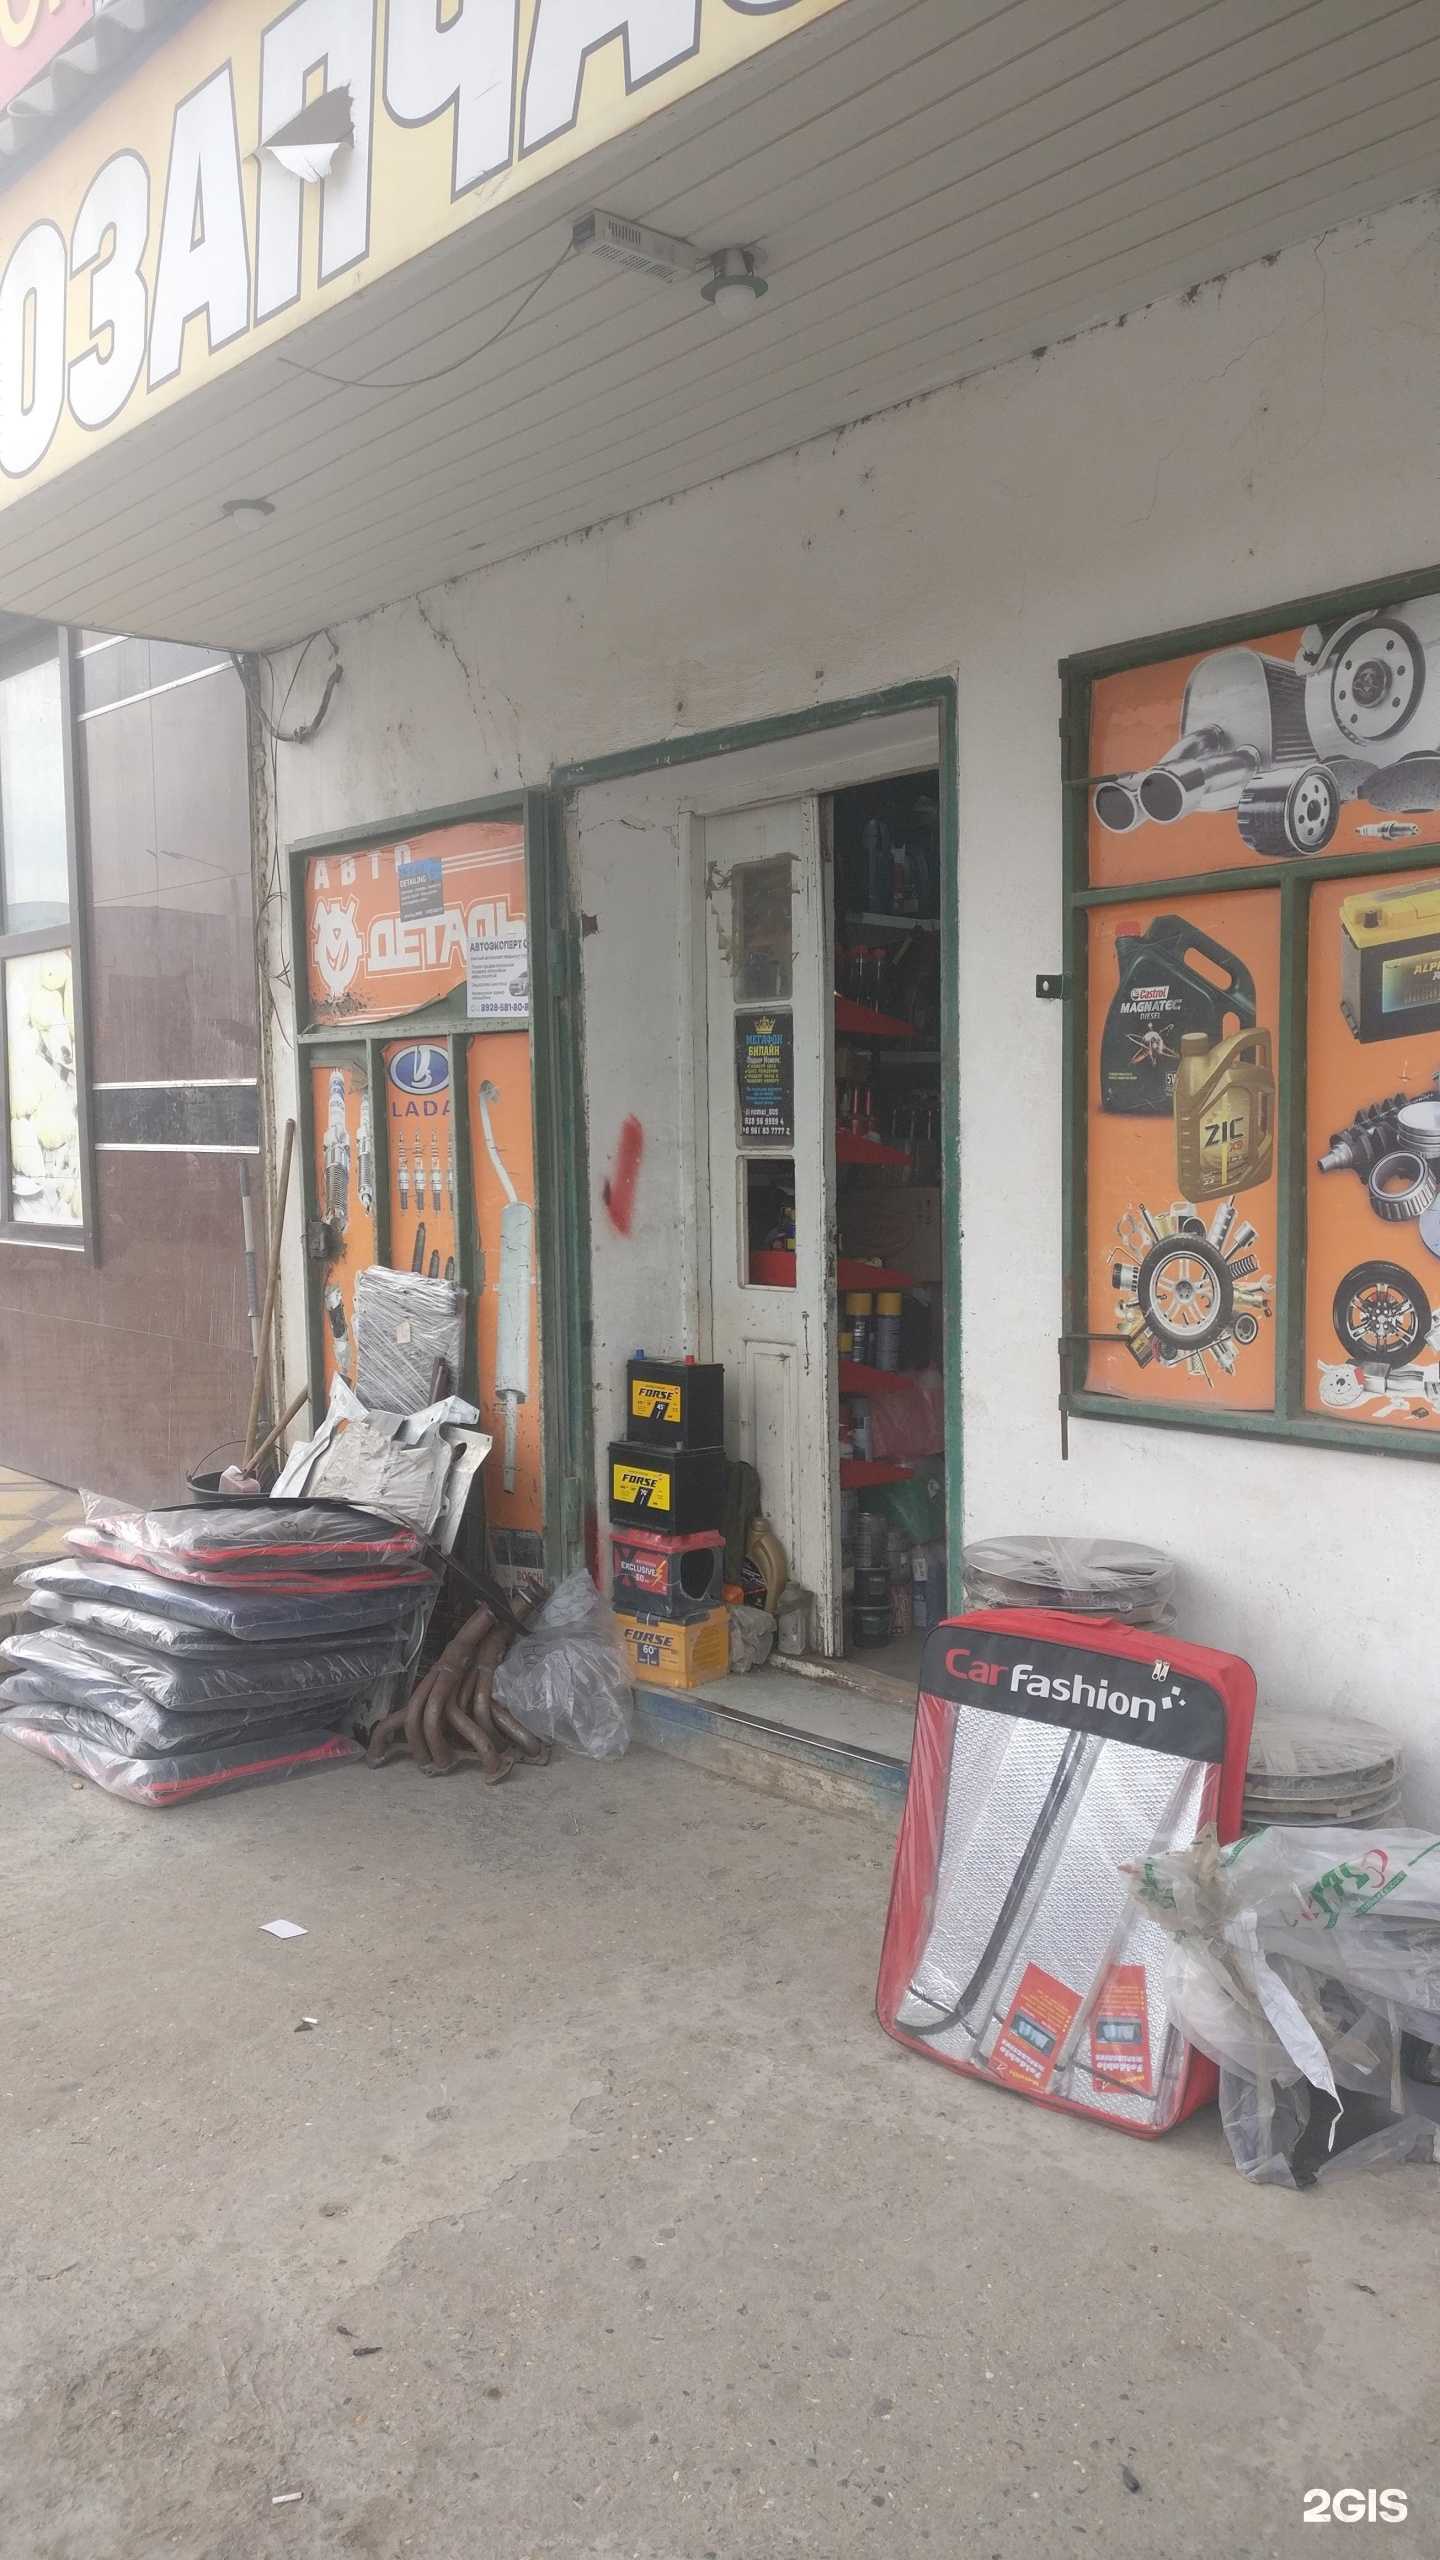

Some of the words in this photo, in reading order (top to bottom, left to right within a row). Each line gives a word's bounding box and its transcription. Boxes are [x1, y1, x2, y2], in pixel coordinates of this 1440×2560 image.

[0, 0, 806, 480] ОЗАПЧ
[367, 900, 528, 972] ДЕТАЛЬ
[1414, 960, 1440, 975] ALP
[1140, 987, 1167, 999] Castrol
[1120, 1000, 1183, 1013] MAGNATEC
[748, 1044, 780, 1056] БИЛАЙН
[392, 1100, 450, 1117] LADA
[1204, 1117, 1244, 1147] ZIC
[639, 1388, 674, 1401] FORSE
[622, 1473, 658, 1488] FORSE
[621, 1560, 657, 1577] EXCLUSIVE
[624, 1628, 674, 1647] FORSE
[643, 1645, 655, 1655] 60
[944, 1648, 1009, 1687] Car
